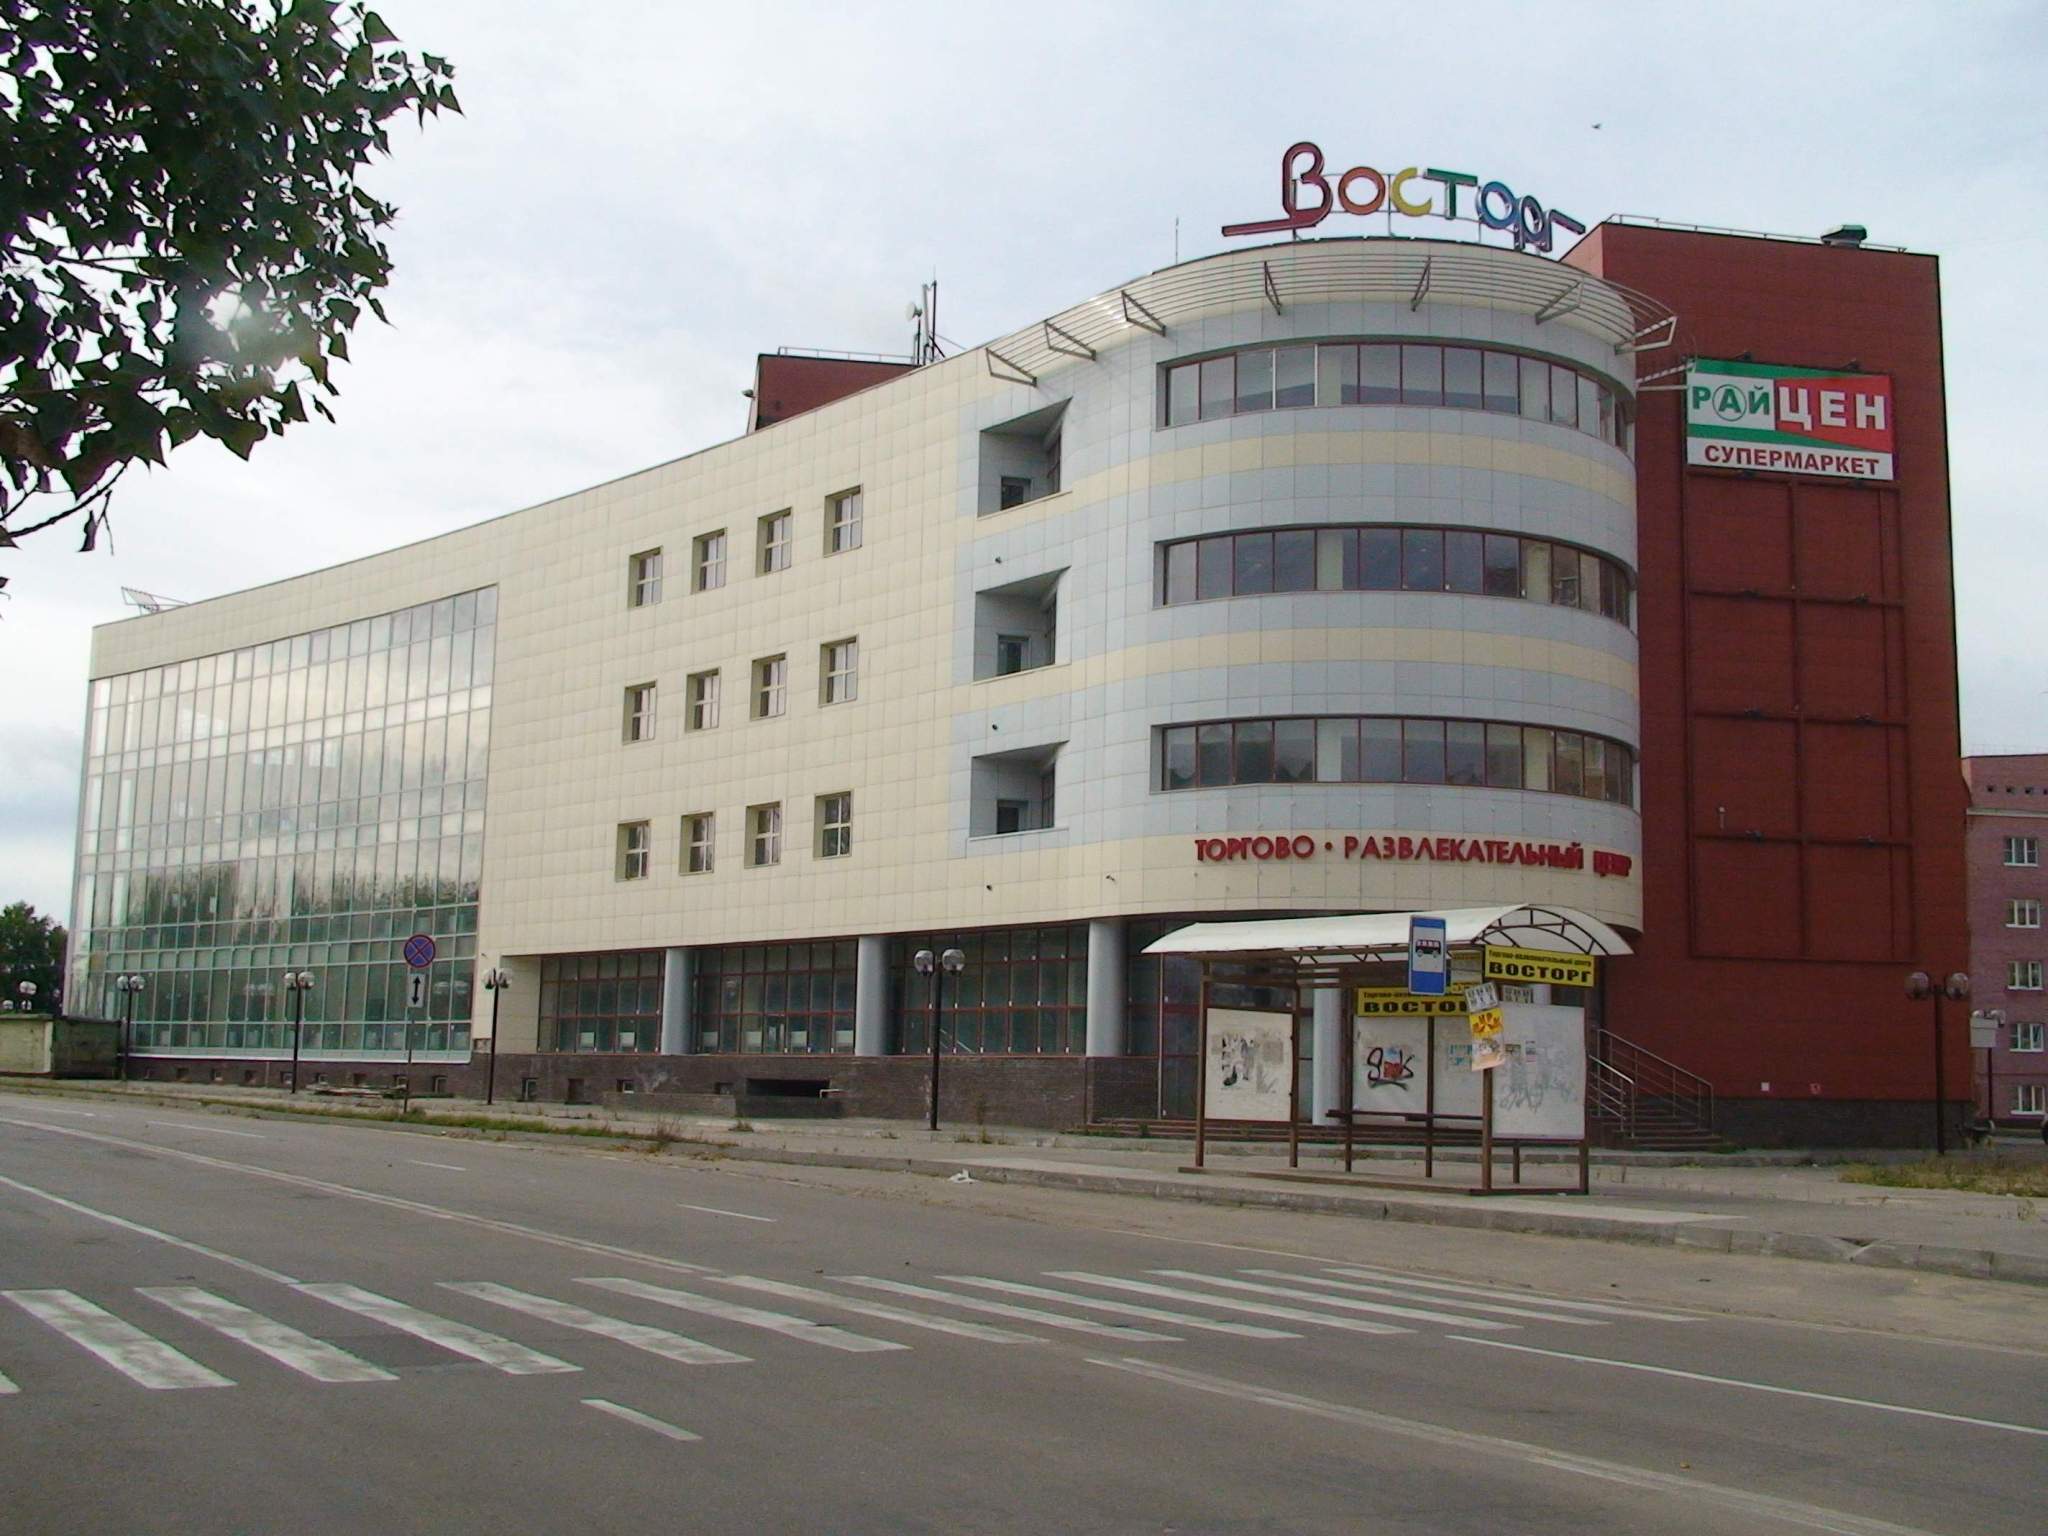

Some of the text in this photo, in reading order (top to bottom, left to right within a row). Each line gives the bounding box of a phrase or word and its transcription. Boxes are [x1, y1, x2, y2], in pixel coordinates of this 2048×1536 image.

[1692, 384, 1886, 431] РАЙ ЦЕН
[1704, 445, 1880, 475] СУПЕРМАРКЕТ
[1195, 835, 1315, 862] ТОРГОВО
[1344, 836, 1584, 870] РАЗВЛЕКАТЕЛЬНЫЙ
[1489, 961, 1591, 982] ВОСТОРГ
[1364, 1001, 1468, 1013] ВОСТО
